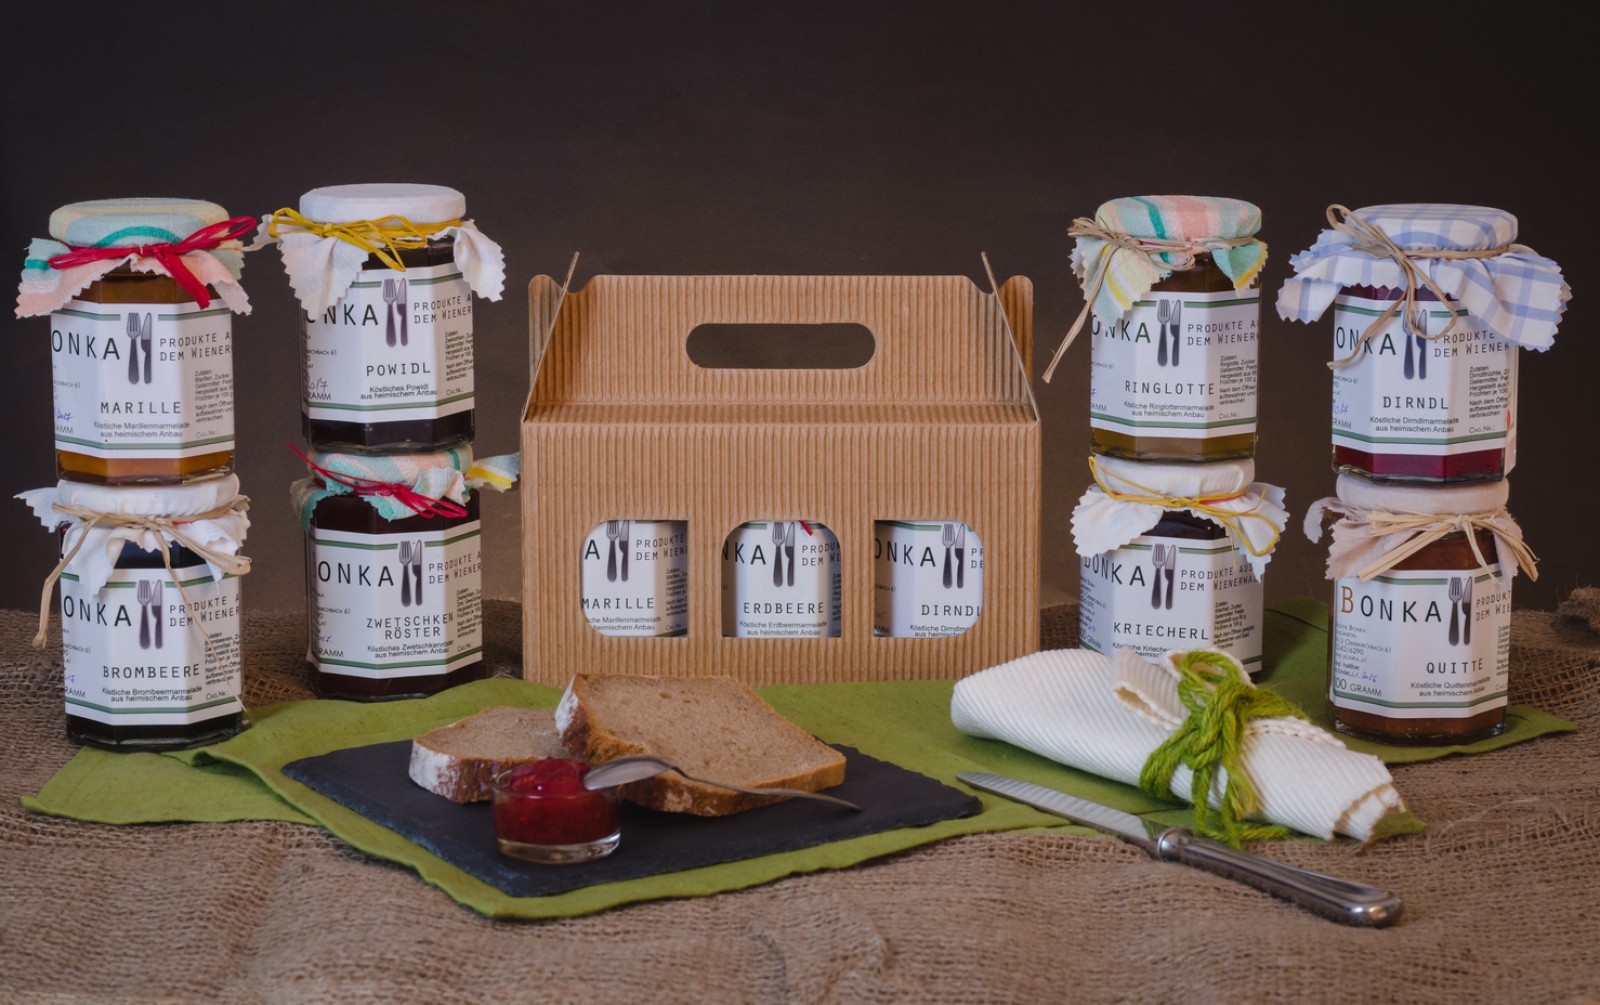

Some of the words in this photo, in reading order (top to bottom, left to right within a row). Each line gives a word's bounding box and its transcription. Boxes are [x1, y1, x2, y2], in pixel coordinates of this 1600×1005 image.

[414, 295, 461, 311] PRODUKTE
[414, 315, 436, 324] DEM
[1188, 320, 1243, 332] PRODUKTE
[160, 333, 217, 347] PRODUKTE
[1187, 336, 1211, 345] DEM
[1435, 331, 1495, 343] RODUKTE
[160, 351, 184, 361] DEM
[1434, 348, 1458, 357] DEM
[366, 363, 431, 376] POWIDL
[406, 383, 429, 391] Powidl
[1125, 380, 1215, 395] RINGLOTTE
[374, 391, 415, 399] heimischem
[101, 402, 181, 414] MARILLE
[1124, 401, 1148, 410] Köstliche
[1149, 403, 1215, 412] Ringlottenmarmelade
[1383, 396, 1448, 409] DIRNDL
[94, 422, 122, 430] Köstliche
[636, 534, 685, 548] PRODUKTE
[636, 551, 658, 560] DEM
[429, 553, 472, 571] PRODUKTE
[802, 558, 823, 566] DEM
[1181, 568, 1233, 579] PRODUKTE
[429, 575, 449, 584] DEM
[1180, 582, 1204, 591] DEM
[581, 598, 654, 609] MARILLE
[744, 602, 824, 614] ERDBEERE
[1341, 586, 1442, 622] BONKA
[921, 605, 981, 616] DIRNDL
[1476, 610, 1490, 621] DEM
[170, 618, 193, 626] DEM
[367, 613, 453, 628] ZWETSCHKEN
[602, 616, 661, 624] Marillenmarmelade
[385, 627, 440, 640] RÖSTER
[1113, 622, 1208, 640] KRIECHERL
[103, 664, 199, 678] BROMBEERE
[1426, 658, 1483, 674] QUITTE
[102, 688, 131, 696] Köstliche
[132, 687, 202, 695] Brombeermarmelade
[1350, 683, 1382, 696] GRAMM
[1433, 689, 1472, 697] heimischem
